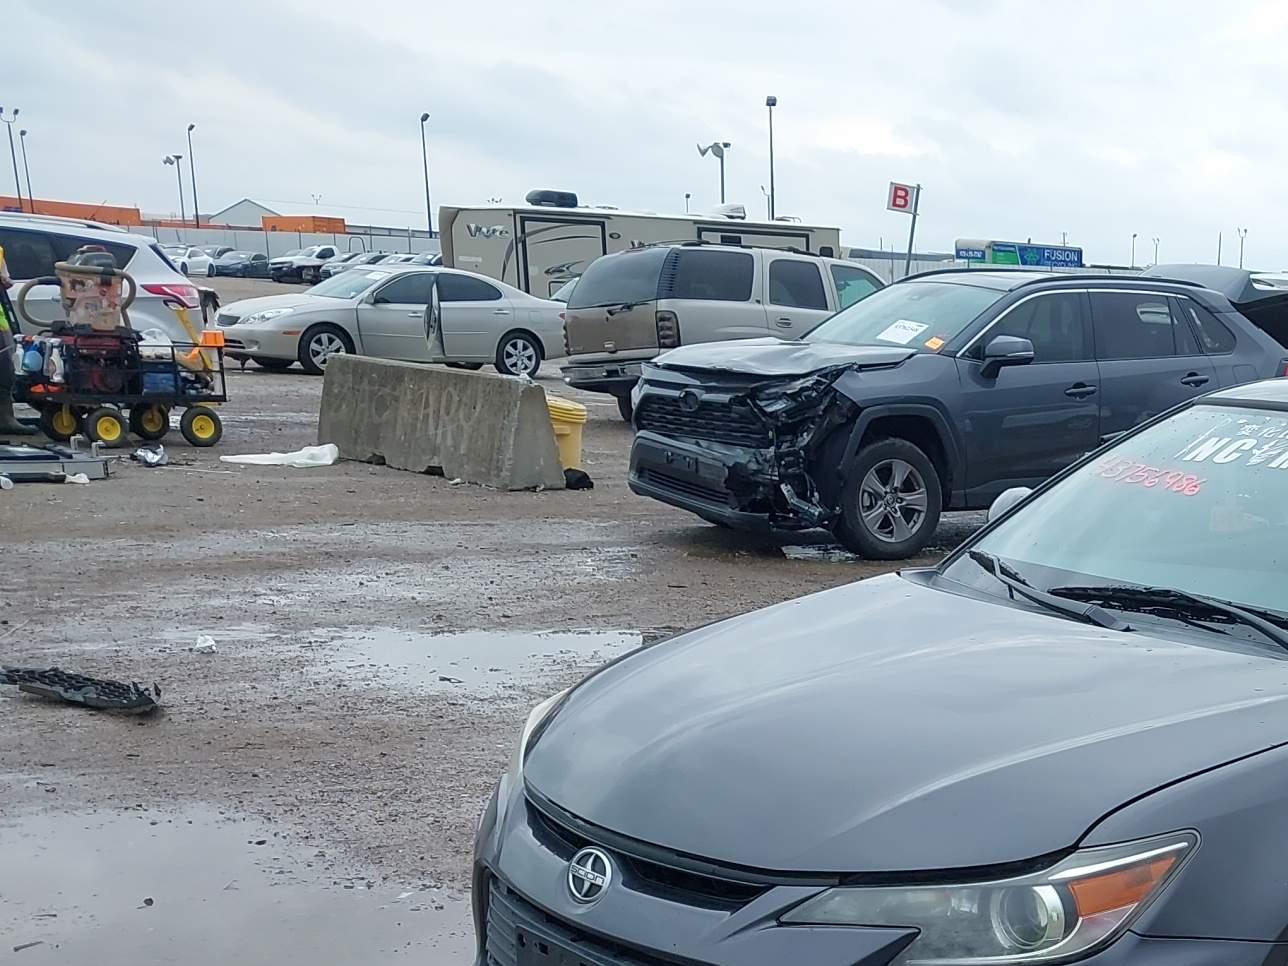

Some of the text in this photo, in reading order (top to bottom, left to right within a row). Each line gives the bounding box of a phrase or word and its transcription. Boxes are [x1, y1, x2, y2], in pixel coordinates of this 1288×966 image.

[892, 186, 909, 208] B
[1044, 249, 1078, 261] FUSION
[570, 864, 605, 885] SCION
